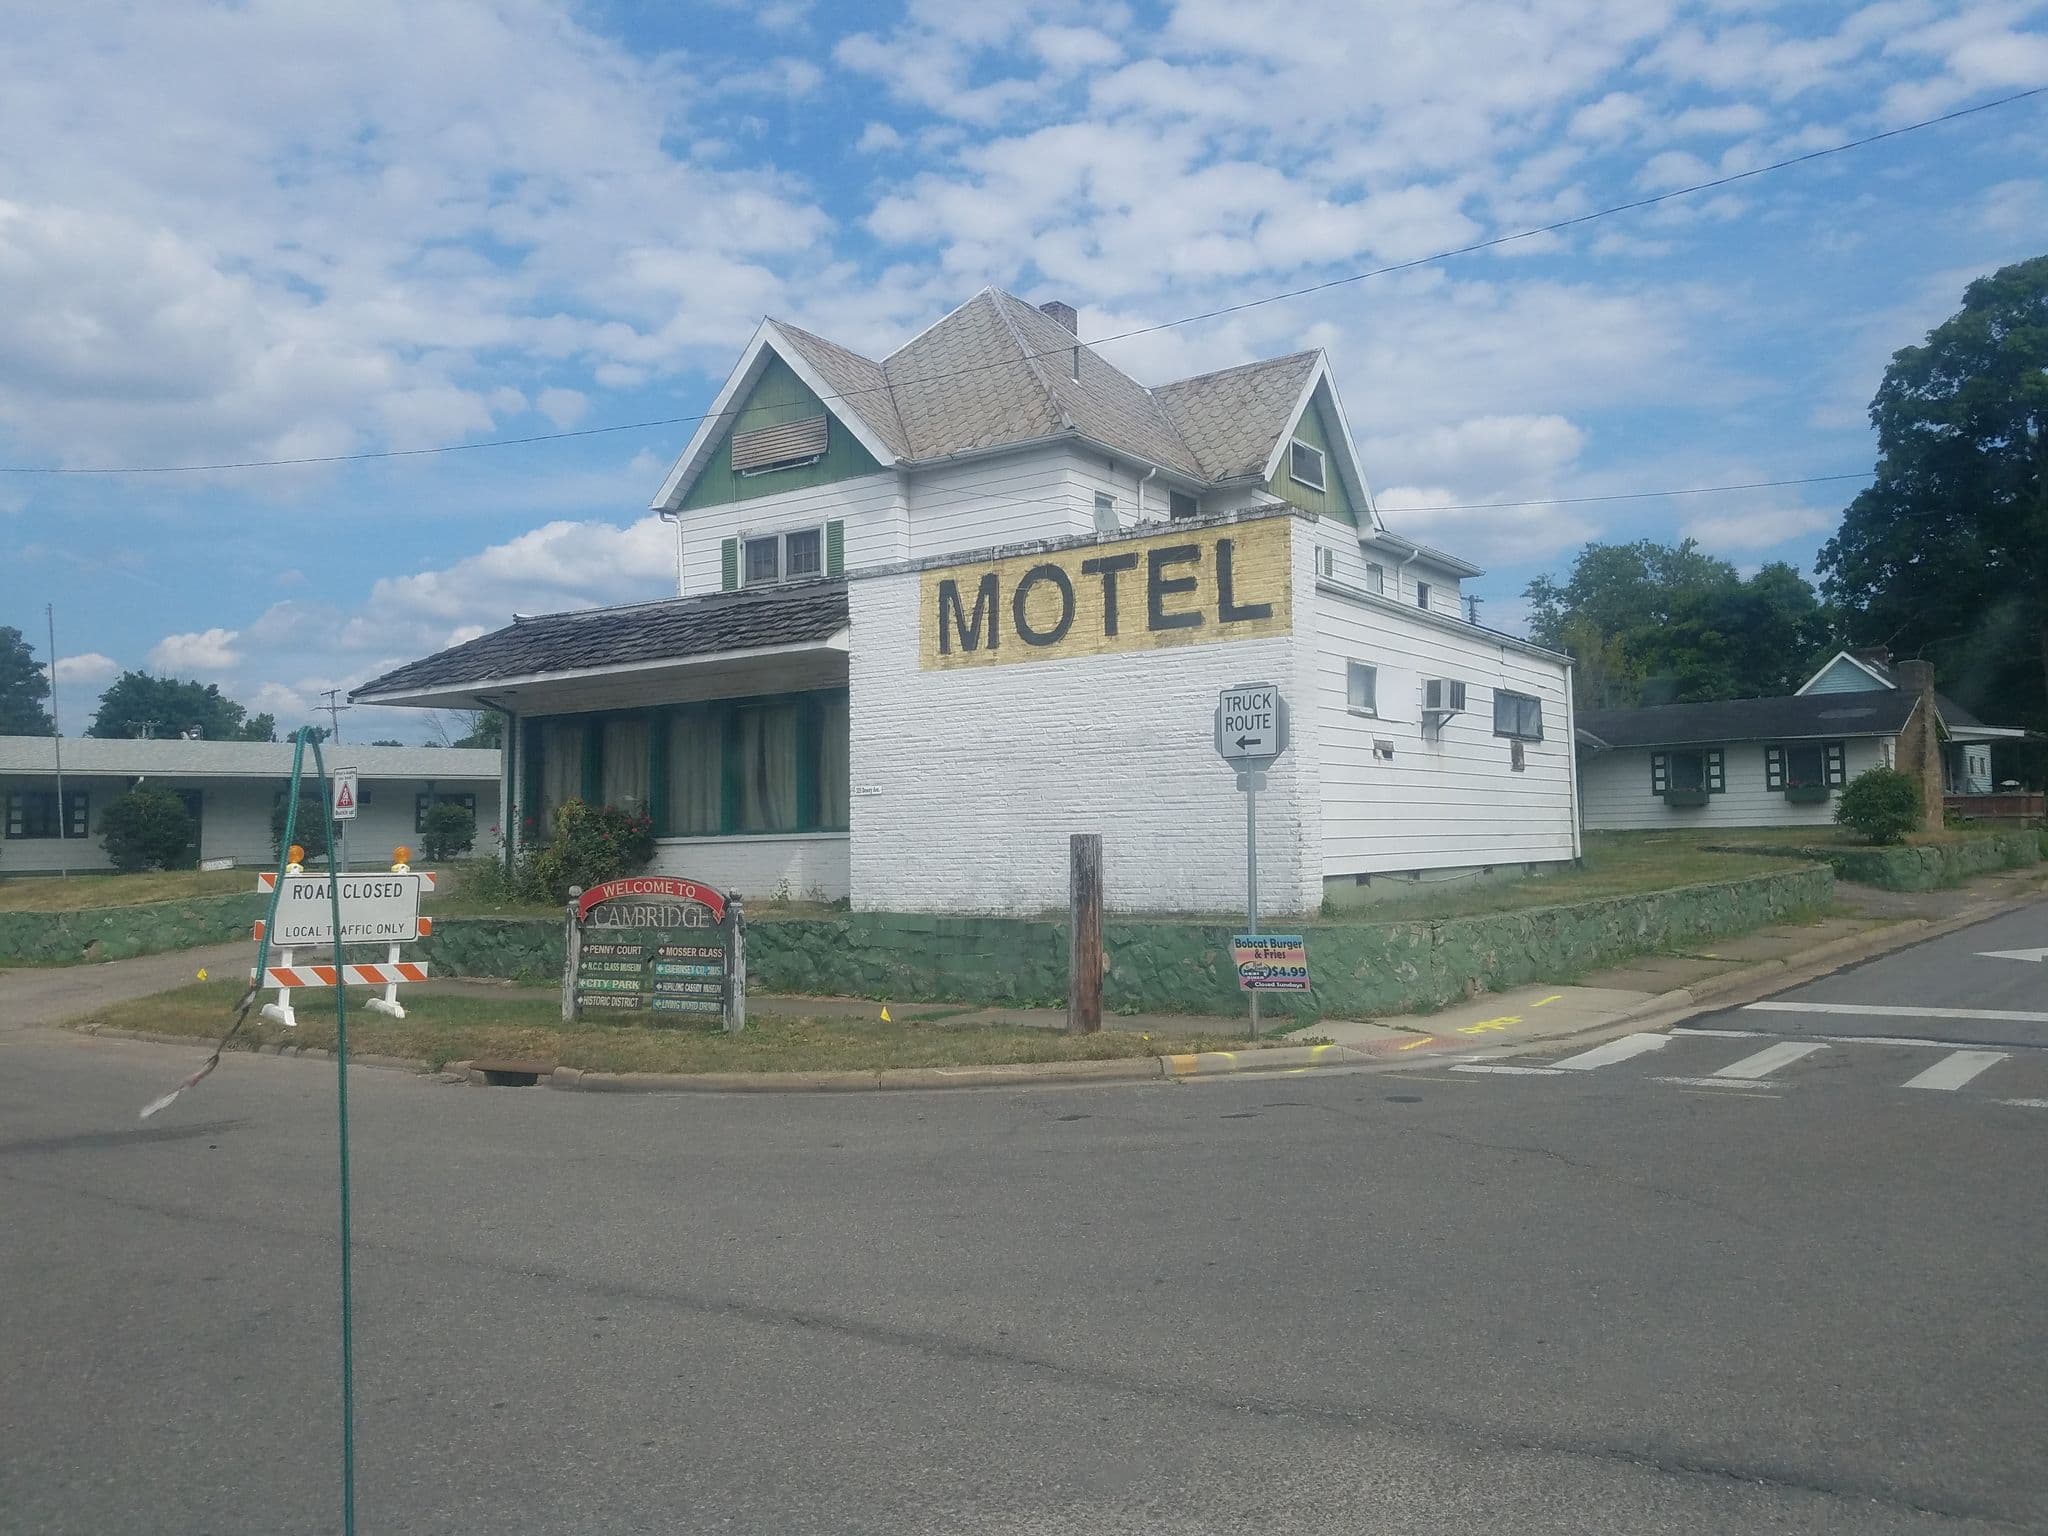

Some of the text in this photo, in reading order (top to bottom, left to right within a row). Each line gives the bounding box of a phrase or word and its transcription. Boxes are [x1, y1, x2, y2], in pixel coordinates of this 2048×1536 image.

[939, 539, 1273, 656] MOTEL
[1225, 692, 1272, 712] TRUCK
[1225, 713, 1272, 732] ROUTE
[343, 883, 404, 899] CLOSED
[602, 881, 696, 898] WELCOME TO
[594, 905, 711, 929] CAMBRIDGE
[285, 923, 406, 938] LOCAL TAFFIC ONLY
[590, 945, 642, 955] PENNY COURT
[1234, 938, 1302, 950] Bobcat Burger
[666, 947, 723, 958] MOSSER GLASS
[1254, 949, 1286, 959] & Fries
[604, 962, 620, 972] GLASS
[620, 962, 642, 972] MUSEUM
[1271, 965, 1306, 977] $4.99
[586, 978, 640, 989] CITY PARK
[703, 984, 722, 993] MUSEUM
[584, 996, 640, 1007] HISTORIC DISTRICT
